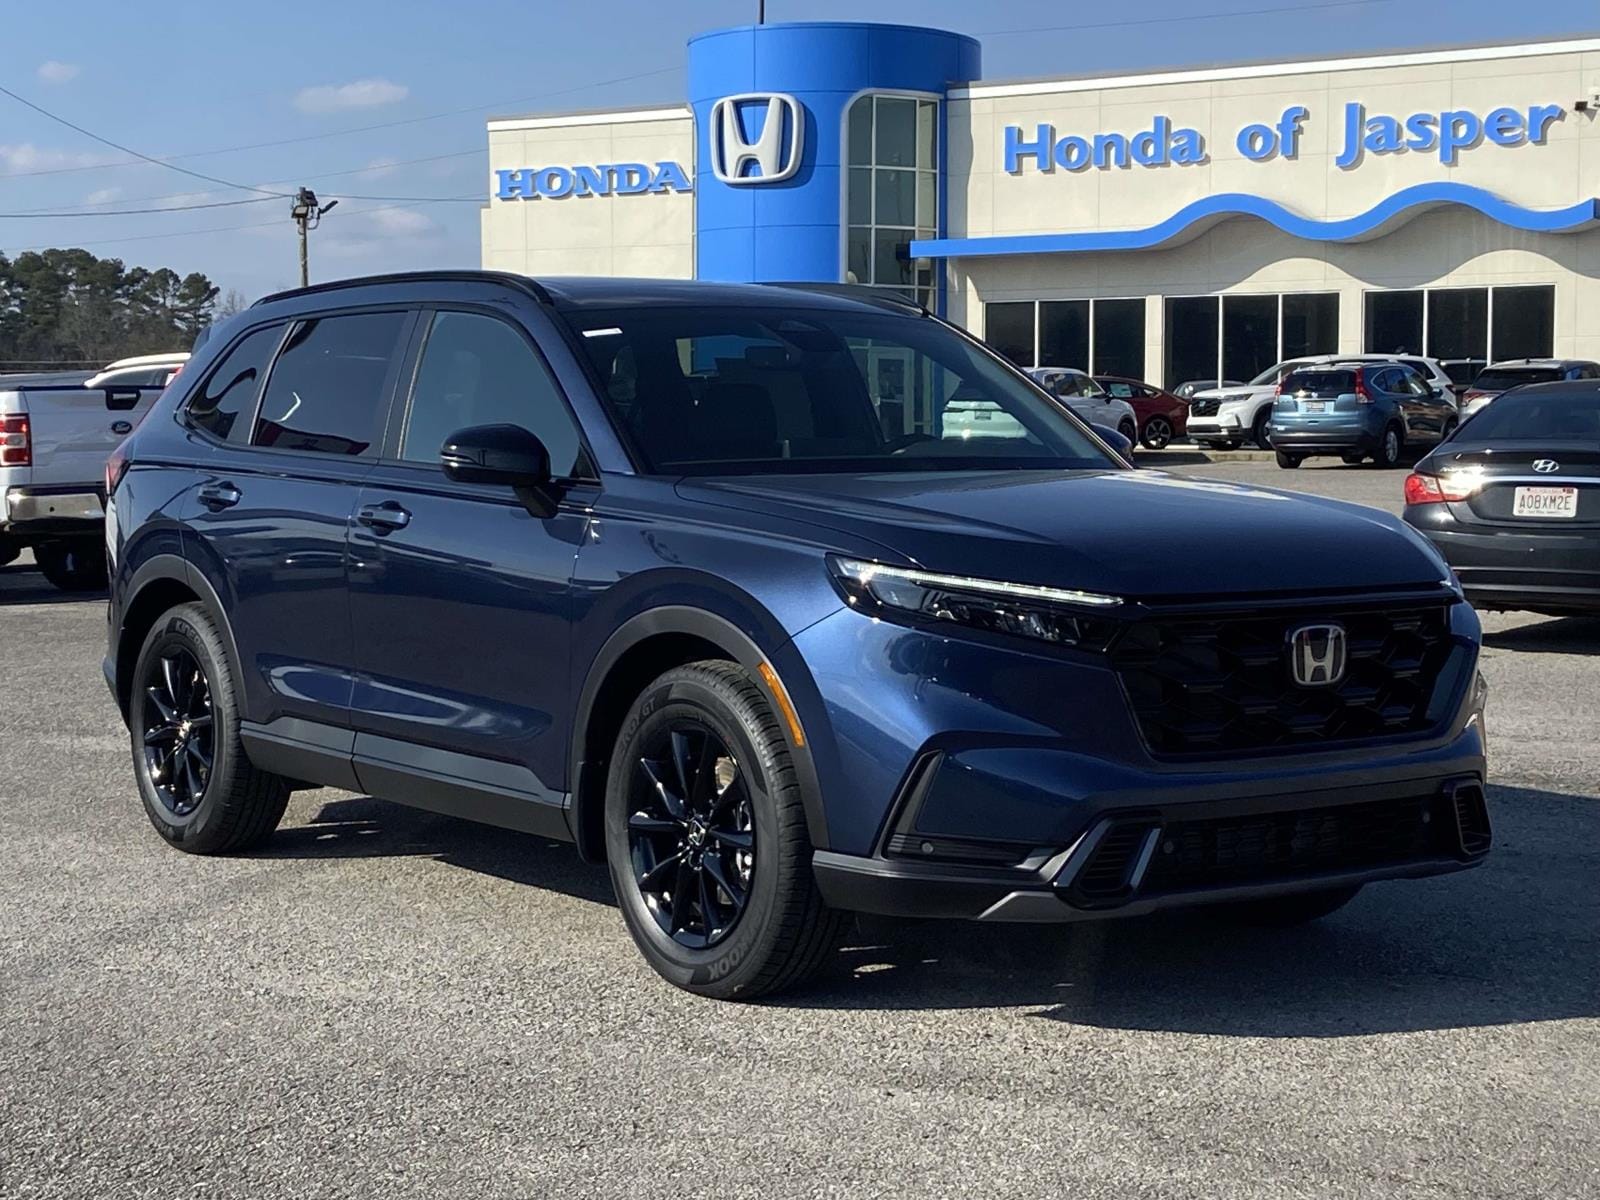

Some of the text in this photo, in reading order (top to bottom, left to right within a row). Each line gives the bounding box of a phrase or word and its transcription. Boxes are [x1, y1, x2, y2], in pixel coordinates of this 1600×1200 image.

[1003, 102, 1562, 174] Honda of Jasper
[495, 161, 692, 200] HONDA
